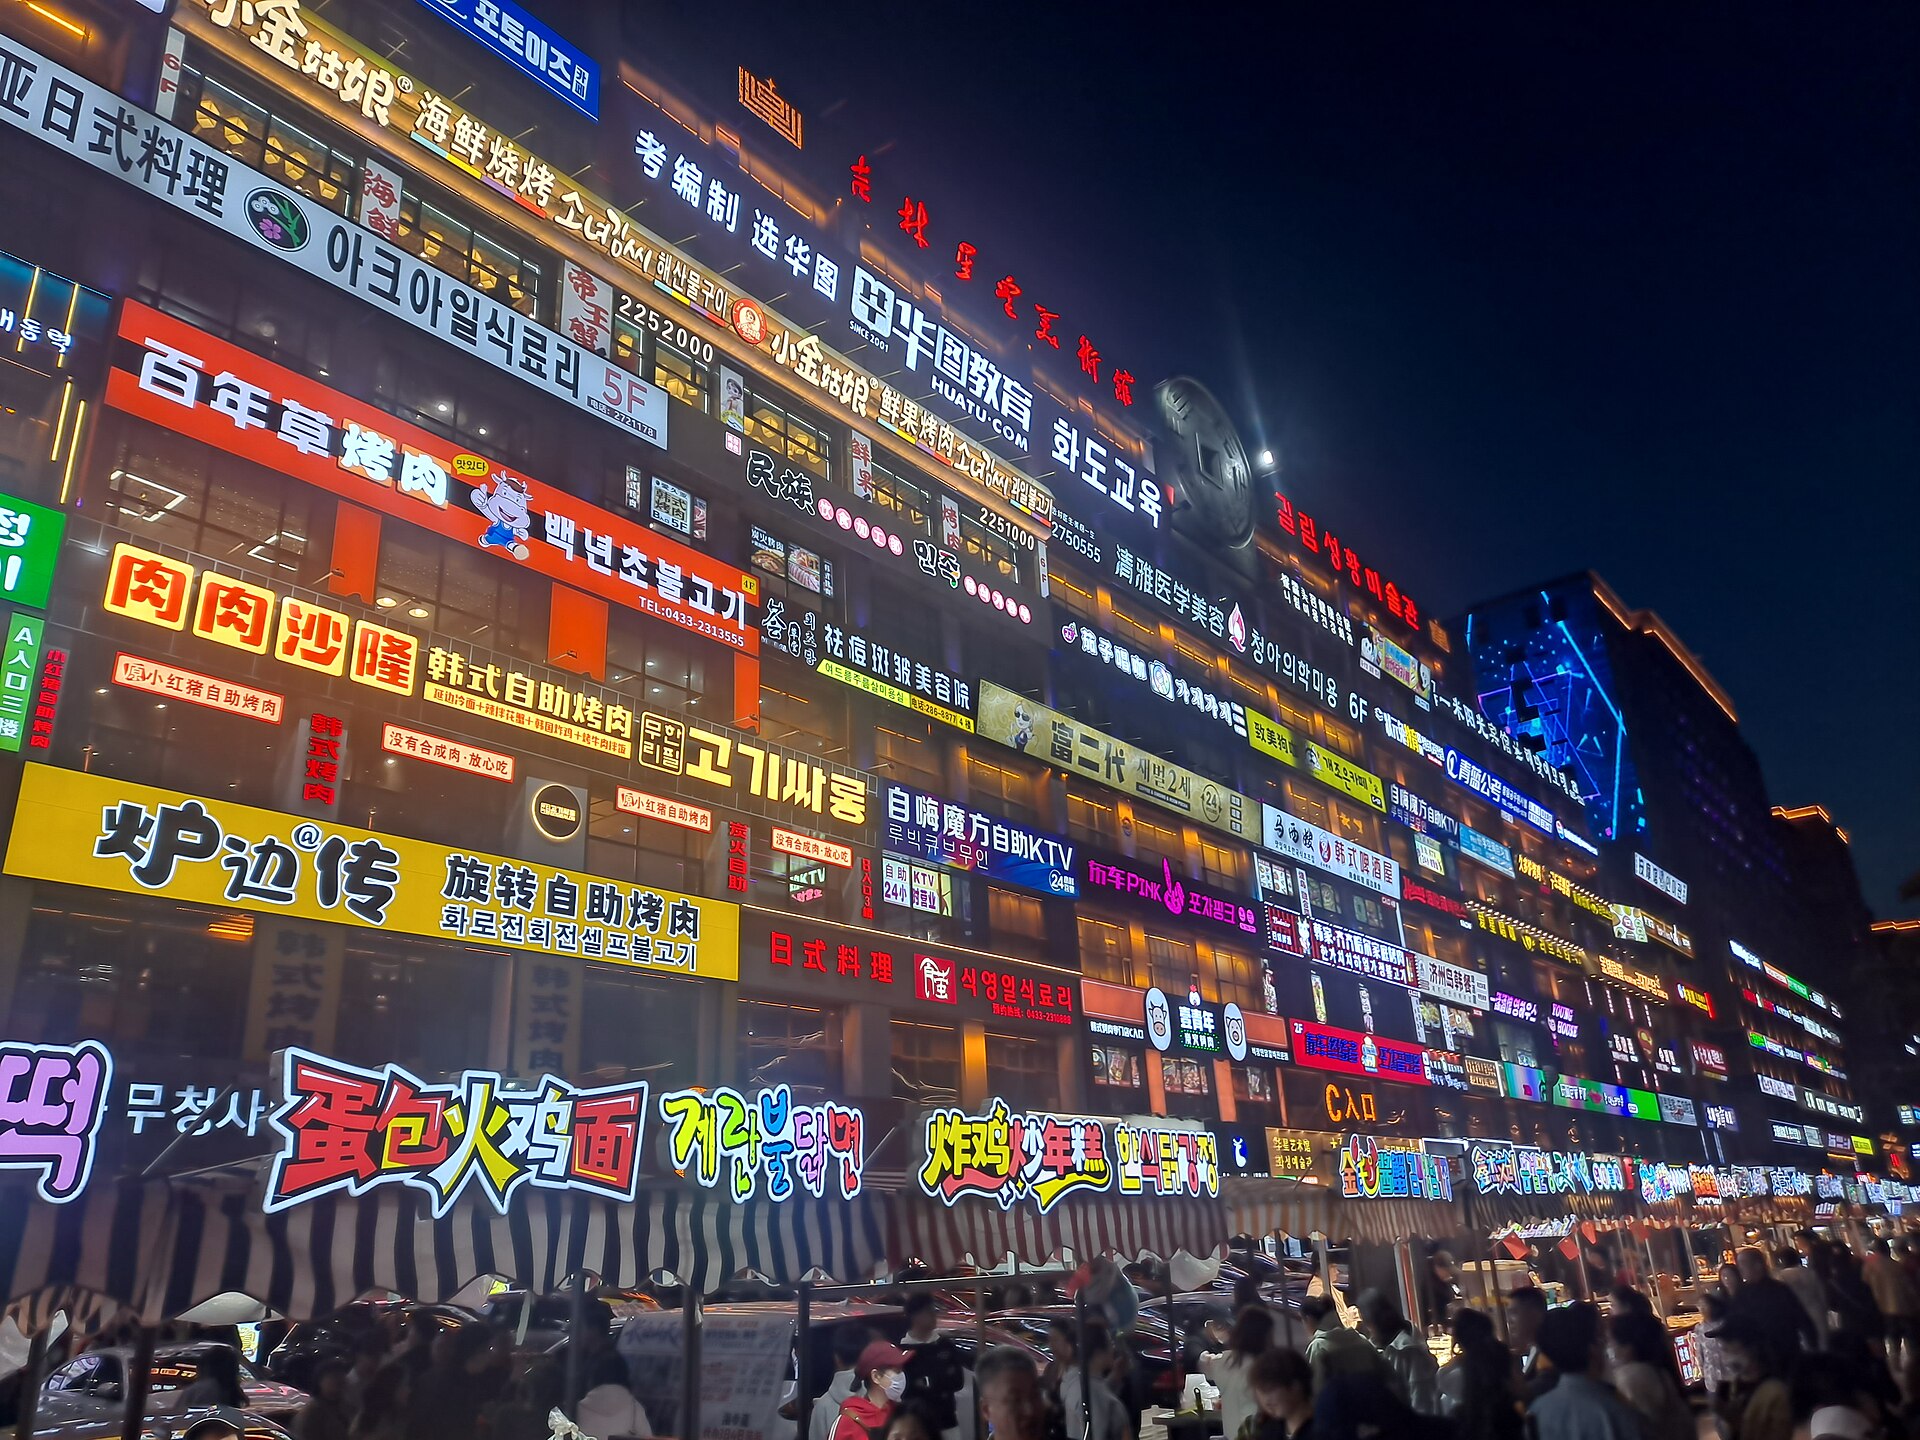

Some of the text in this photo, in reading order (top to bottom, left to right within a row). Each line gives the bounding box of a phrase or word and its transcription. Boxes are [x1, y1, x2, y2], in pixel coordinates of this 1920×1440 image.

[160, 54, 181, 93] 6F
[474, 0, 572, 89] 포토이즈
[0, 49, 229, 218] 亚日式料理
[414, 91, 556, 208] 海鲜烧烤
[362, 168, 399, 242] 海鲜
[634, 129, 840, 301] 考编制 选华图
[326, 225, 580, 399] 아크아일식료리
[567, 266, 611, 353] 帝王蟹
[656, 252, 729, 318] 해산물구이
[619, 294, 714, 363] 2252000
[850, 321, 889, 352] SINCE 2001
[604, 366, 648, 413] 5F
[771, 330, 869, 418] 小金姑娘
[892, 298, 1034, 432] 华图教育
[139, 337, 449, 506] 百年草烤肉
[614, 409, 654, 437] 2721178
[880, 386, 955, 458] 鲜果烤肉
[456, 457, 487, 473] 맛있다
[746, 452, 816, 516] 民族
[851, 437, 873, 492] 鲜果
[1052, 417, 1162, 528] 화도교육
[671, 518, 688, 531] 5F
[942, 504, 960, 550] 烤肉
[979, 507, 1035, 551] 2251000
[1051, 521, 1101, 563] 2750555
[545, 511, 745, 631] 백년초불고기
[743, 579, 755, 590] 4F
[1040, 557, 1048, 584] 6F
[1115, 544, 1225, 638] 清雅医学美容
[111, 554, 413, 690] 肉肉沙隆
[639, 596, 745, 648] TEL:0433-2313555
[427, 646, 634, 738] 韩式自助烤肉
[824, 623, 970, 710] 祛痘斑皱美容院
[1251, 628, 1338, 708] 청아의학미용
[30, 649, 68, 749] 小红猪自助烤肉
[645, 719, 683, 742] 무한
[1349, 692, 1368, 723] 6F
[303, 712, 344, 806] 韩式烤肉
[389, 731, 510, 776] 没有合成肉·放心吃
[643, 739, 680, 770] 리필
[686, 727, 867, 825] 고기싸롱
[1050, 720, 1126, 784] 富二代
[888, 786, 1073, 871] 自嗨魔方自助KTV
[1206, 790, 1218, 808] 24
[728, 821, 749, 893] 炭火自助
[776, 832, 849, 863] 没有合成肉·放心吃
[885, 863, 935, 887] 自助 KTV
[888, 823, 989, 870] 루빅큐브무인
[1335, 840, 1393, 884] 韩式啤酒屋
[440, 854, 700, 941] 旋转自助烤肉
[884, 881, 936, 910] 24小时营业
[1189, 892, 1236, 925] 포차핑크
[440, 905, 698, 970] 화로전회전셀프불고기
[770, 931, 893, 984] 日式料理
[961, 967, 1073, 1013] 식영일식료리
[1293, 1022, 1304, 1034] 2F
[1557, 1020, 1579, 1039] HOUSE
[270, 1056, 646, 1208] 蛋包火鸡面
[1325, 1083, 1378, 1122] C入口
[662, 1086, 862, 1200] 계란불닭면
[921, 1104, 1110, 1194] 炸鸡炒年糕
[1117, 1123, 1218, 1197] 한식닭강정
